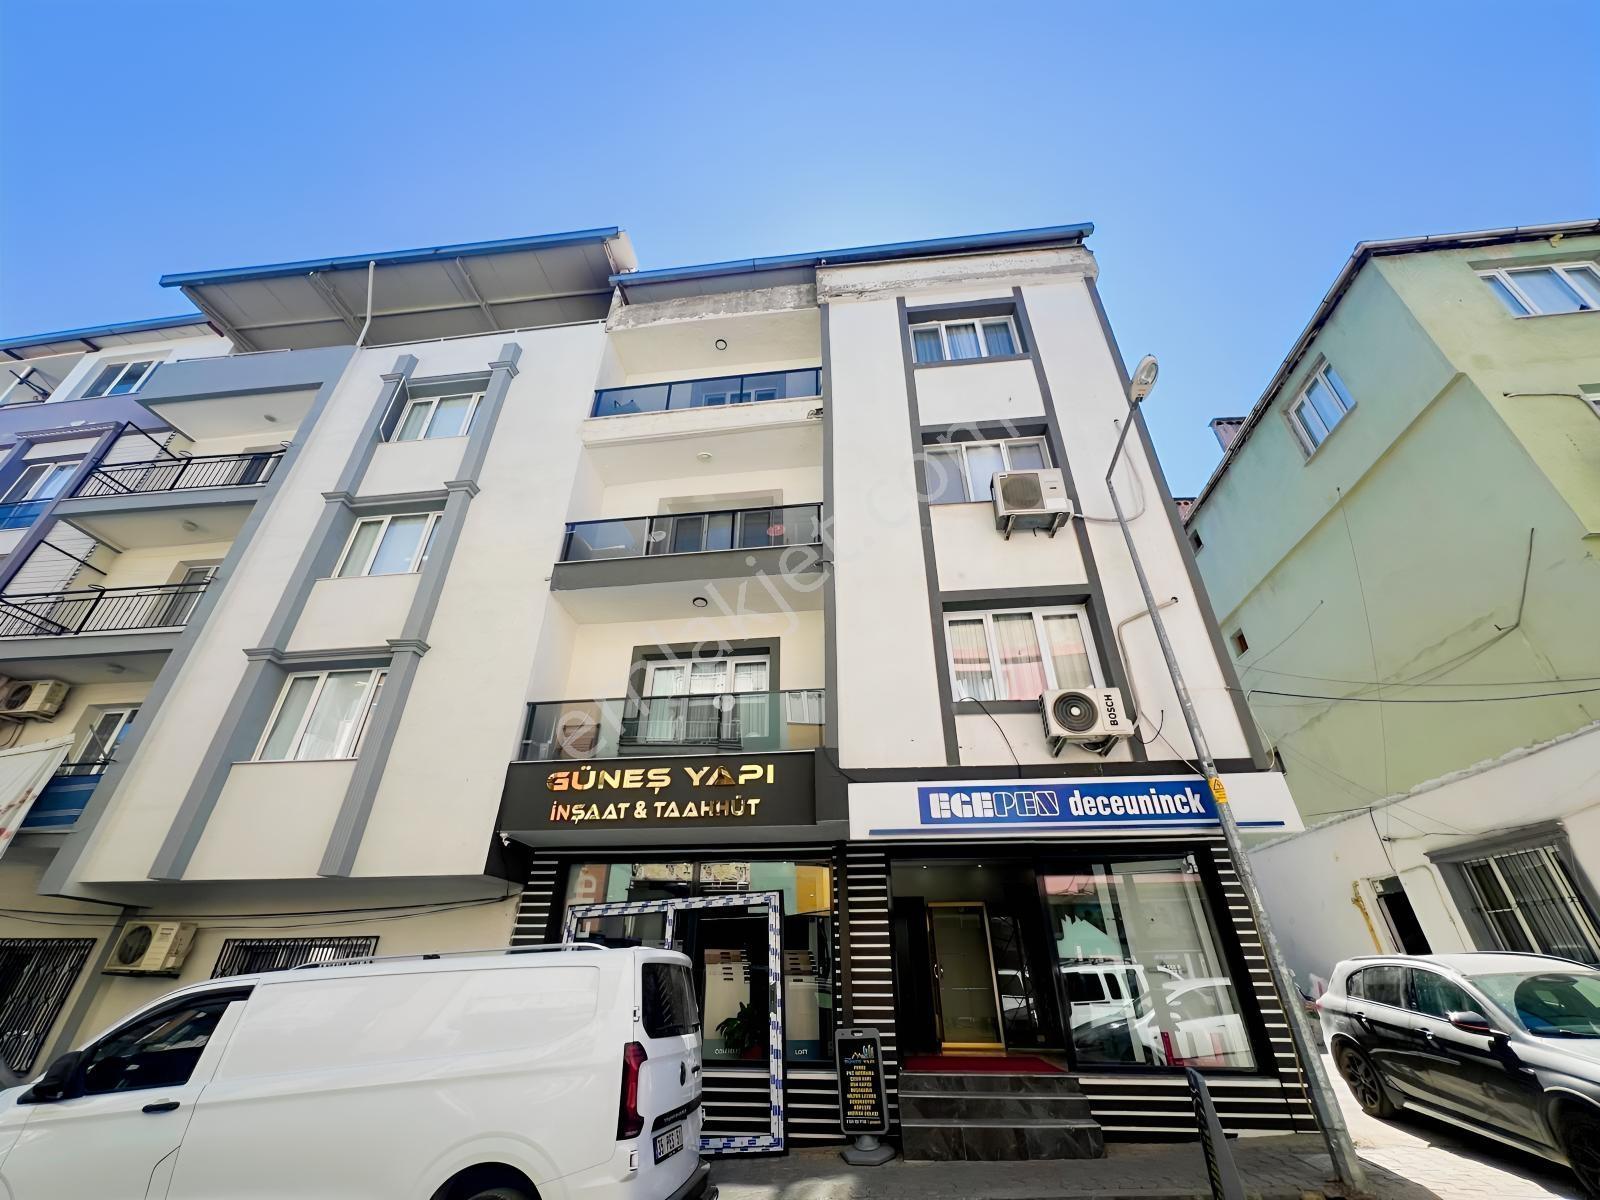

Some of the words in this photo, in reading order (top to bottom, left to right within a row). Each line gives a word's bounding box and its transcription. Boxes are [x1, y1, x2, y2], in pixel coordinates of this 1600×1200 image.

[1103, 694, 1119, 726] BOSCH
[546, 764, 672, 795] GÜNEŞ
[683, 763, 775, 787] YAPI
[549, 800, 630, 825] İNŞAAT
[633, 803, 648, 819] &
[653, 794, 761, 819] TAAHHÜT
[928, 789, 1060, 819] EGEPEN
[1069, 786, 1206, 817] deceuninck
